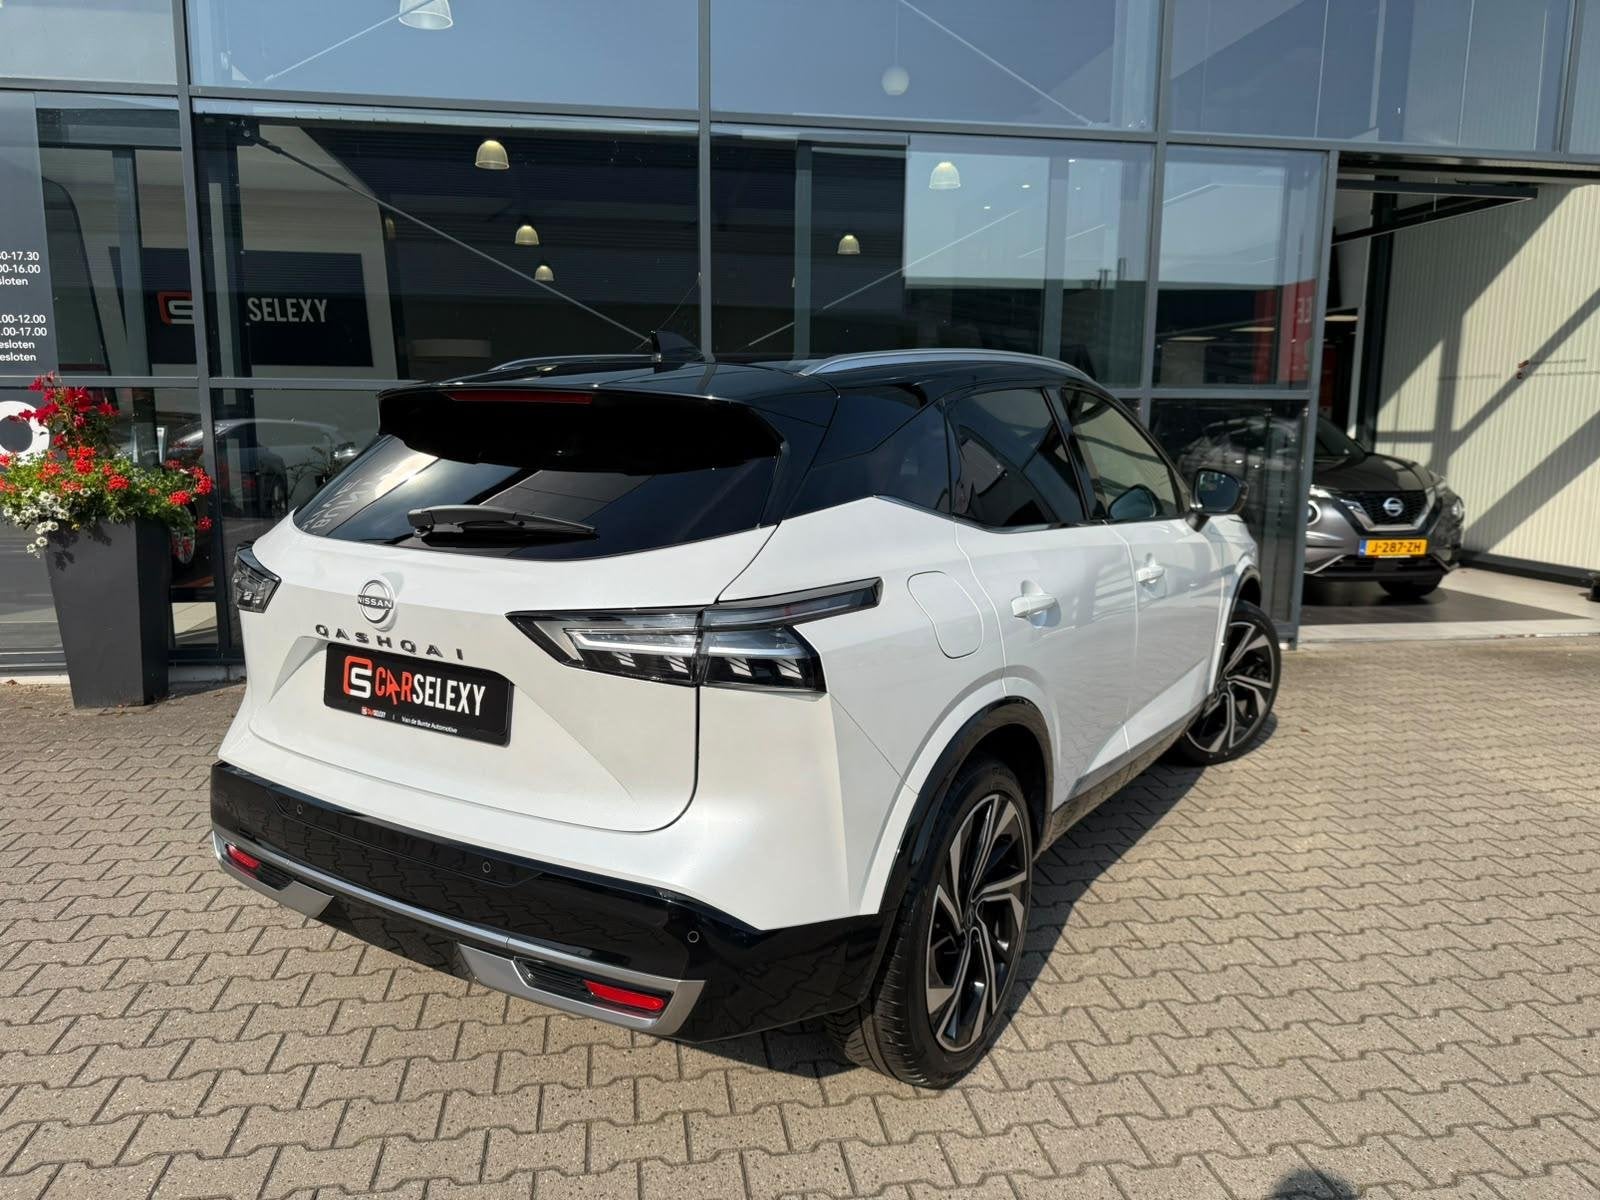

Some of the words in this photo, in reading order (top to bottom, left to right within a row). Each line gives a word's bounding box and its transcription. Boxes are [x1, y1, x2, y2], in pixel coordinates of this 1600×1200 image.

[247, 297, 328, 323] SELEXY
[1371, 541, 1422, 553] J-287-ZH
[358, 595, 393, 609] NISSAN
[315, 624, 464, 661] QASHQAI
